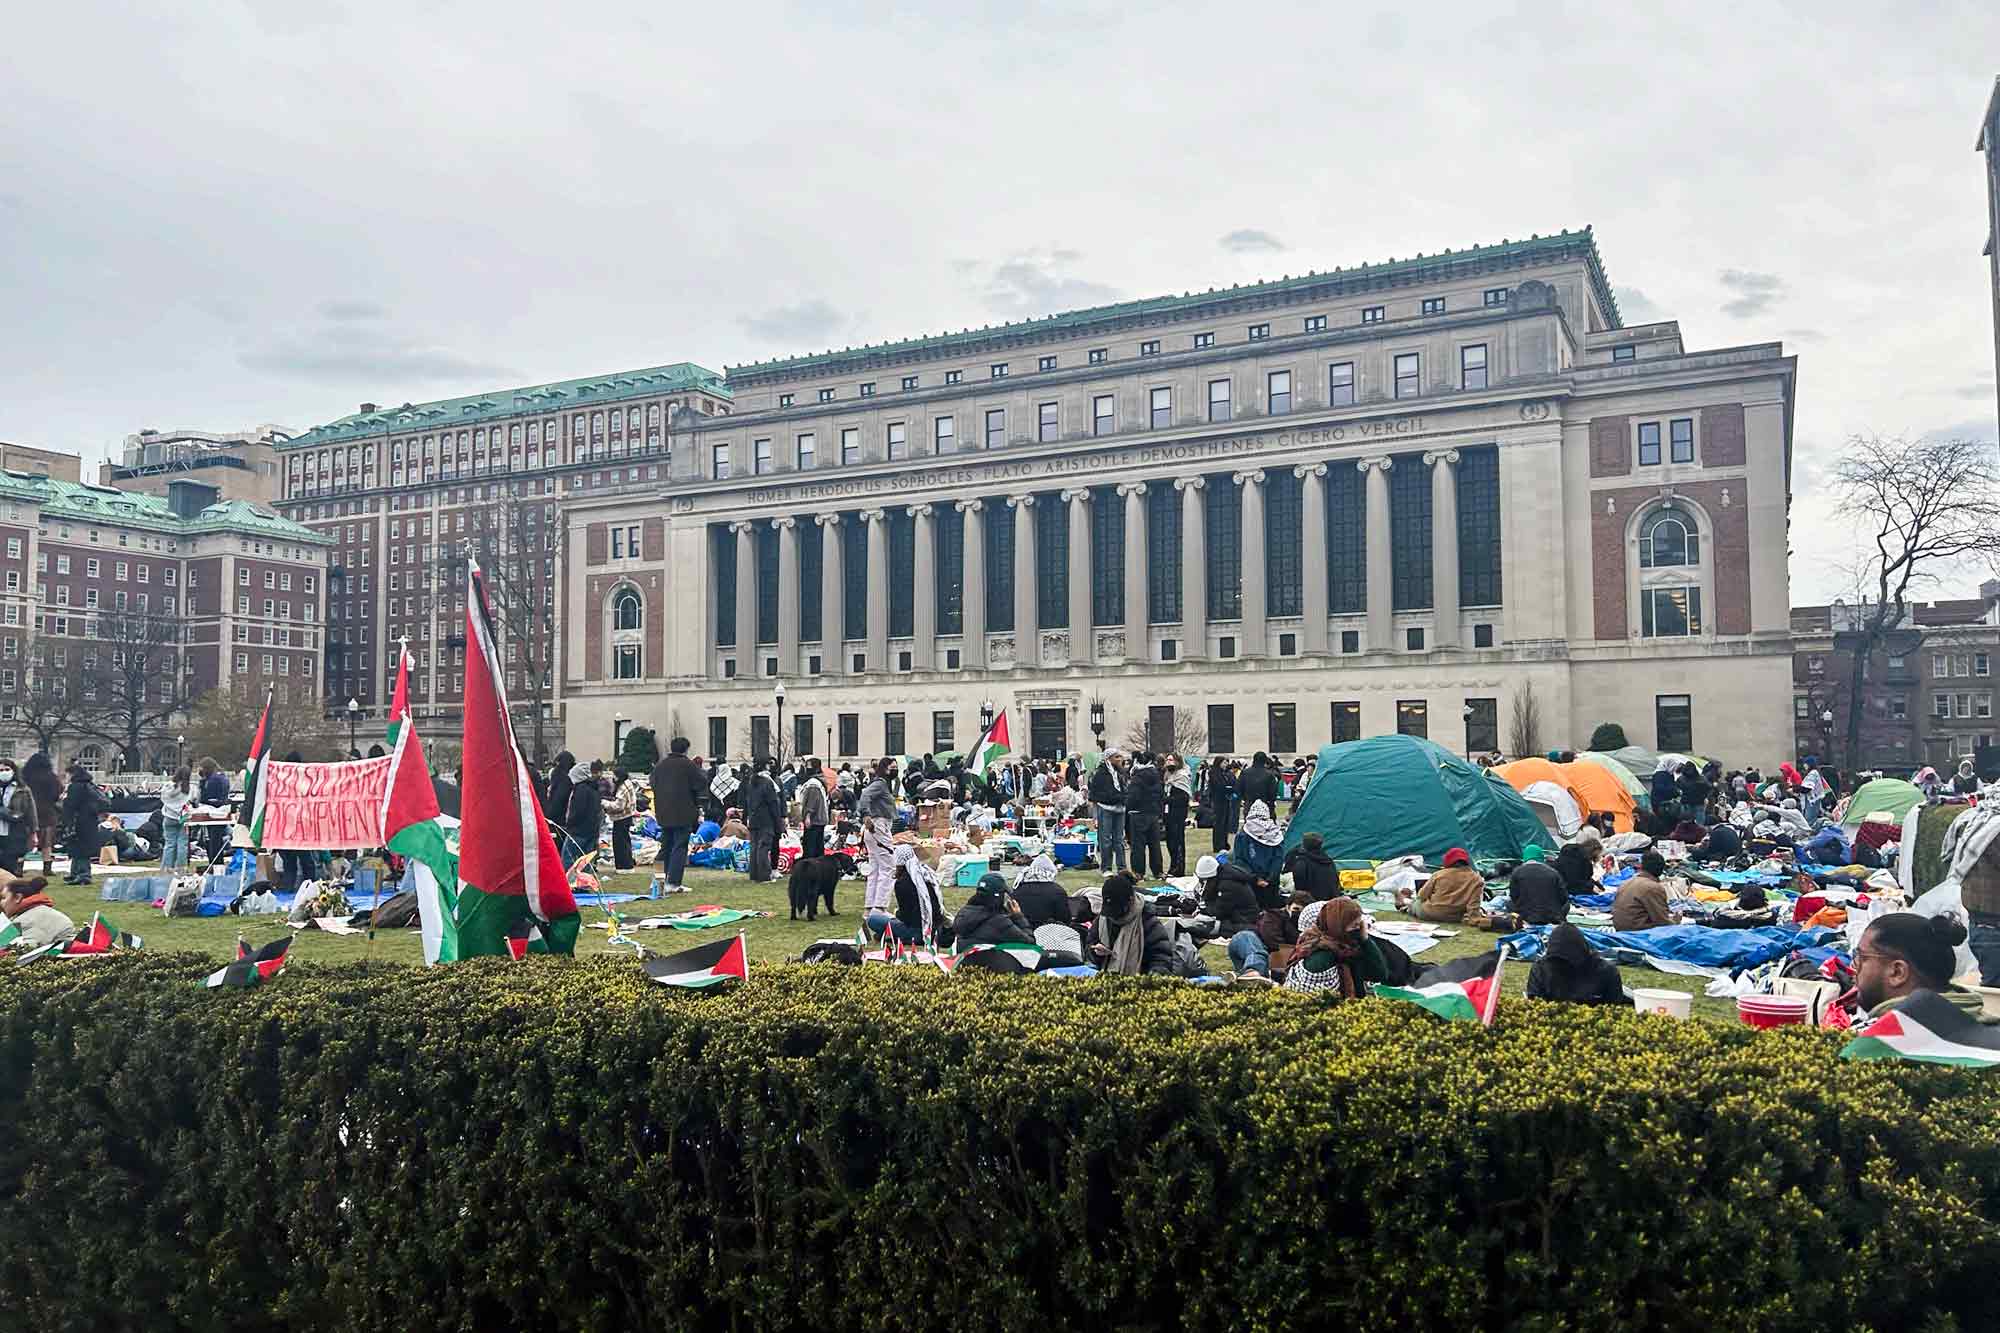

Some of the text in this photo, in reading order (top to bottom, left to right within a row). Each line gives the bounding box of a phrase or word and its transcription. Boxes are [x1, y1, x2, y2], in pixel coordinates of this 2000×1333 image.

[748, 416, 1428, 504] HOMER HERODOTUS SOPHOCLES PLATO ARISTOTLE DEMOSTHENES CICERO VERGIL
